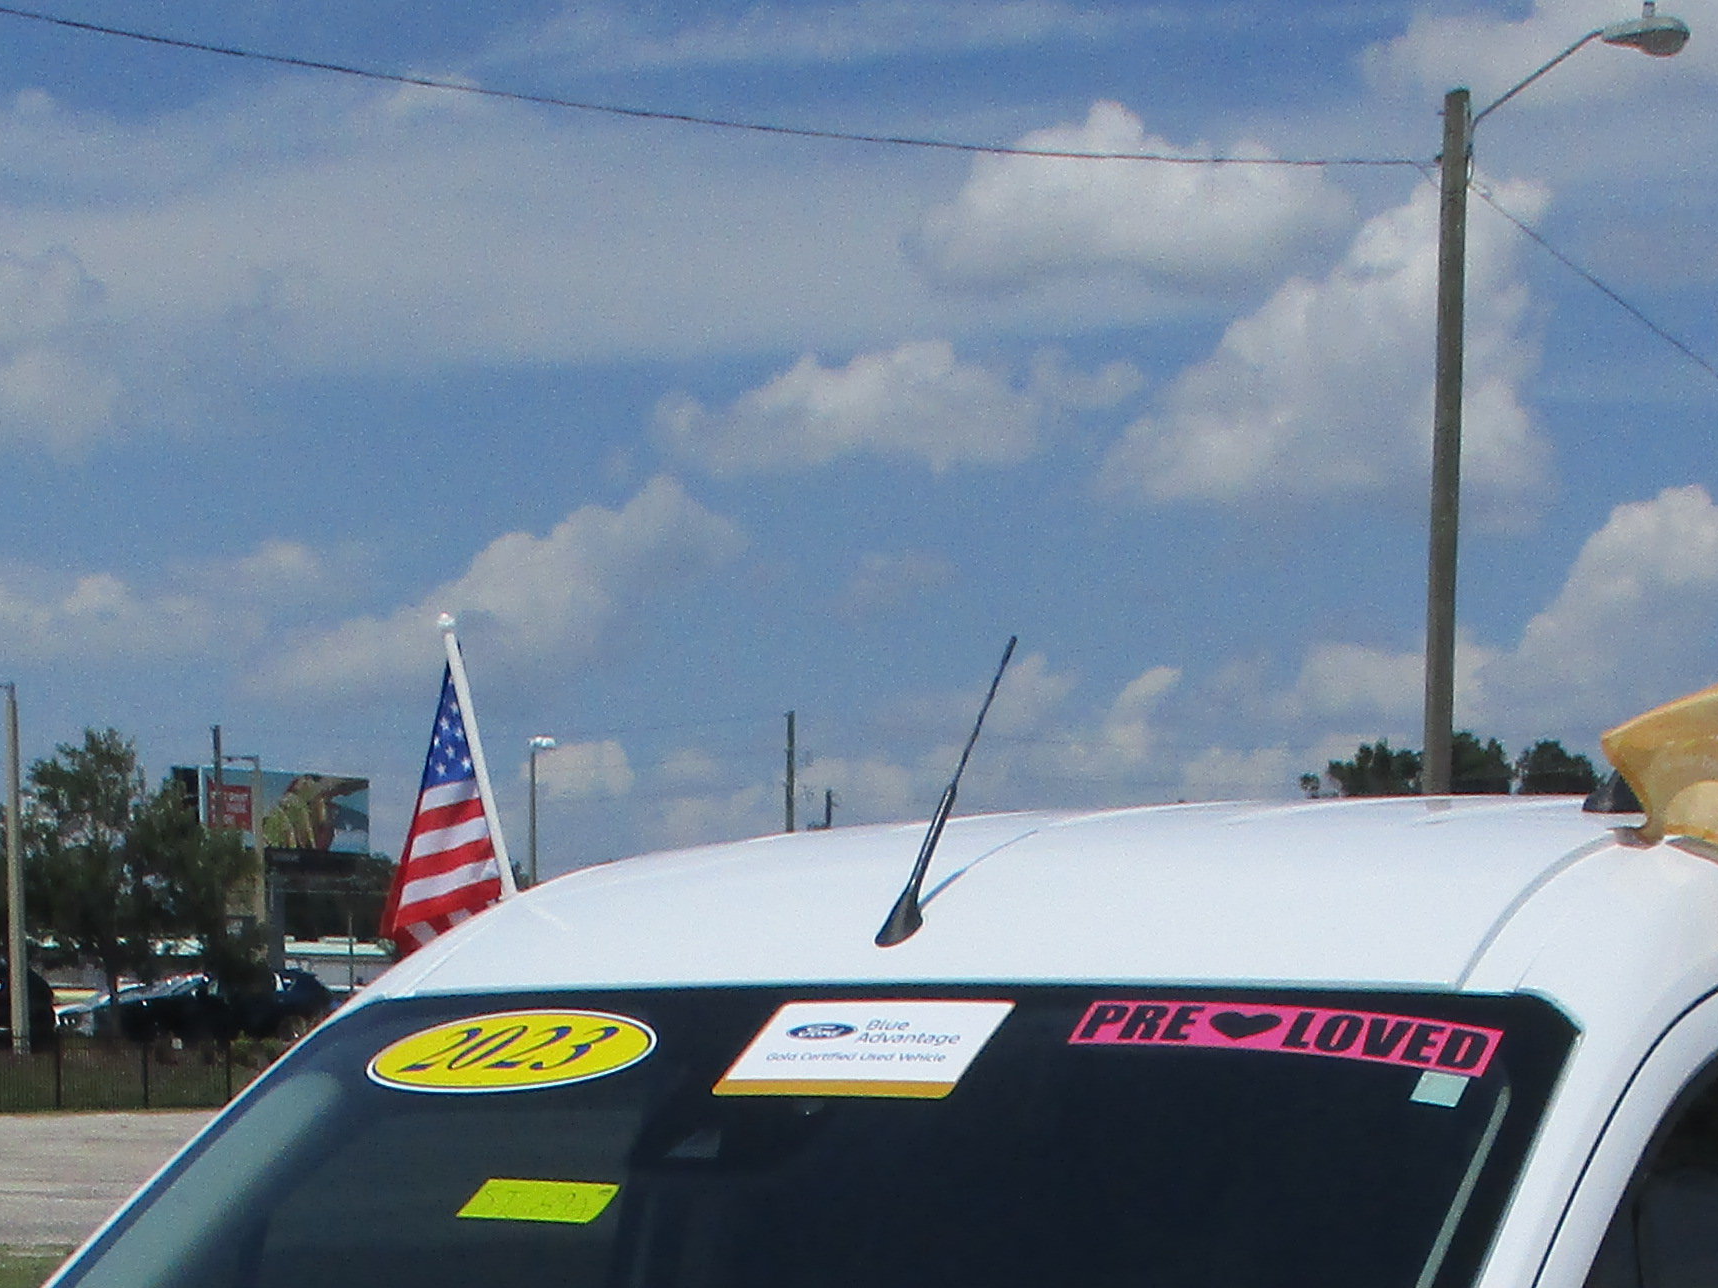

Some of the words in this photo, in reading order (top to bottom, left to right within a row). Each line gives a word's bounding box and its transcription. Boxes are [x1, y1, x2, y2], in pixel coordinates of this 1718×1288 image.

[865, 1019, 910, 1031] Blue
[854, 1032, 961, 1046] Advantage
[1082, 1003, 1204, 1041] PRE
[1281, 1011, 1490, 1071] LOVED
[395, 1025, 620, 1073] 2023
[765, 1052, 798, 1062] Gold
[799, 1051, 857, 1062] Certified
[859, 1052, 895, 1062] Used
[898, 1052, 947, 1063] Vehicle
